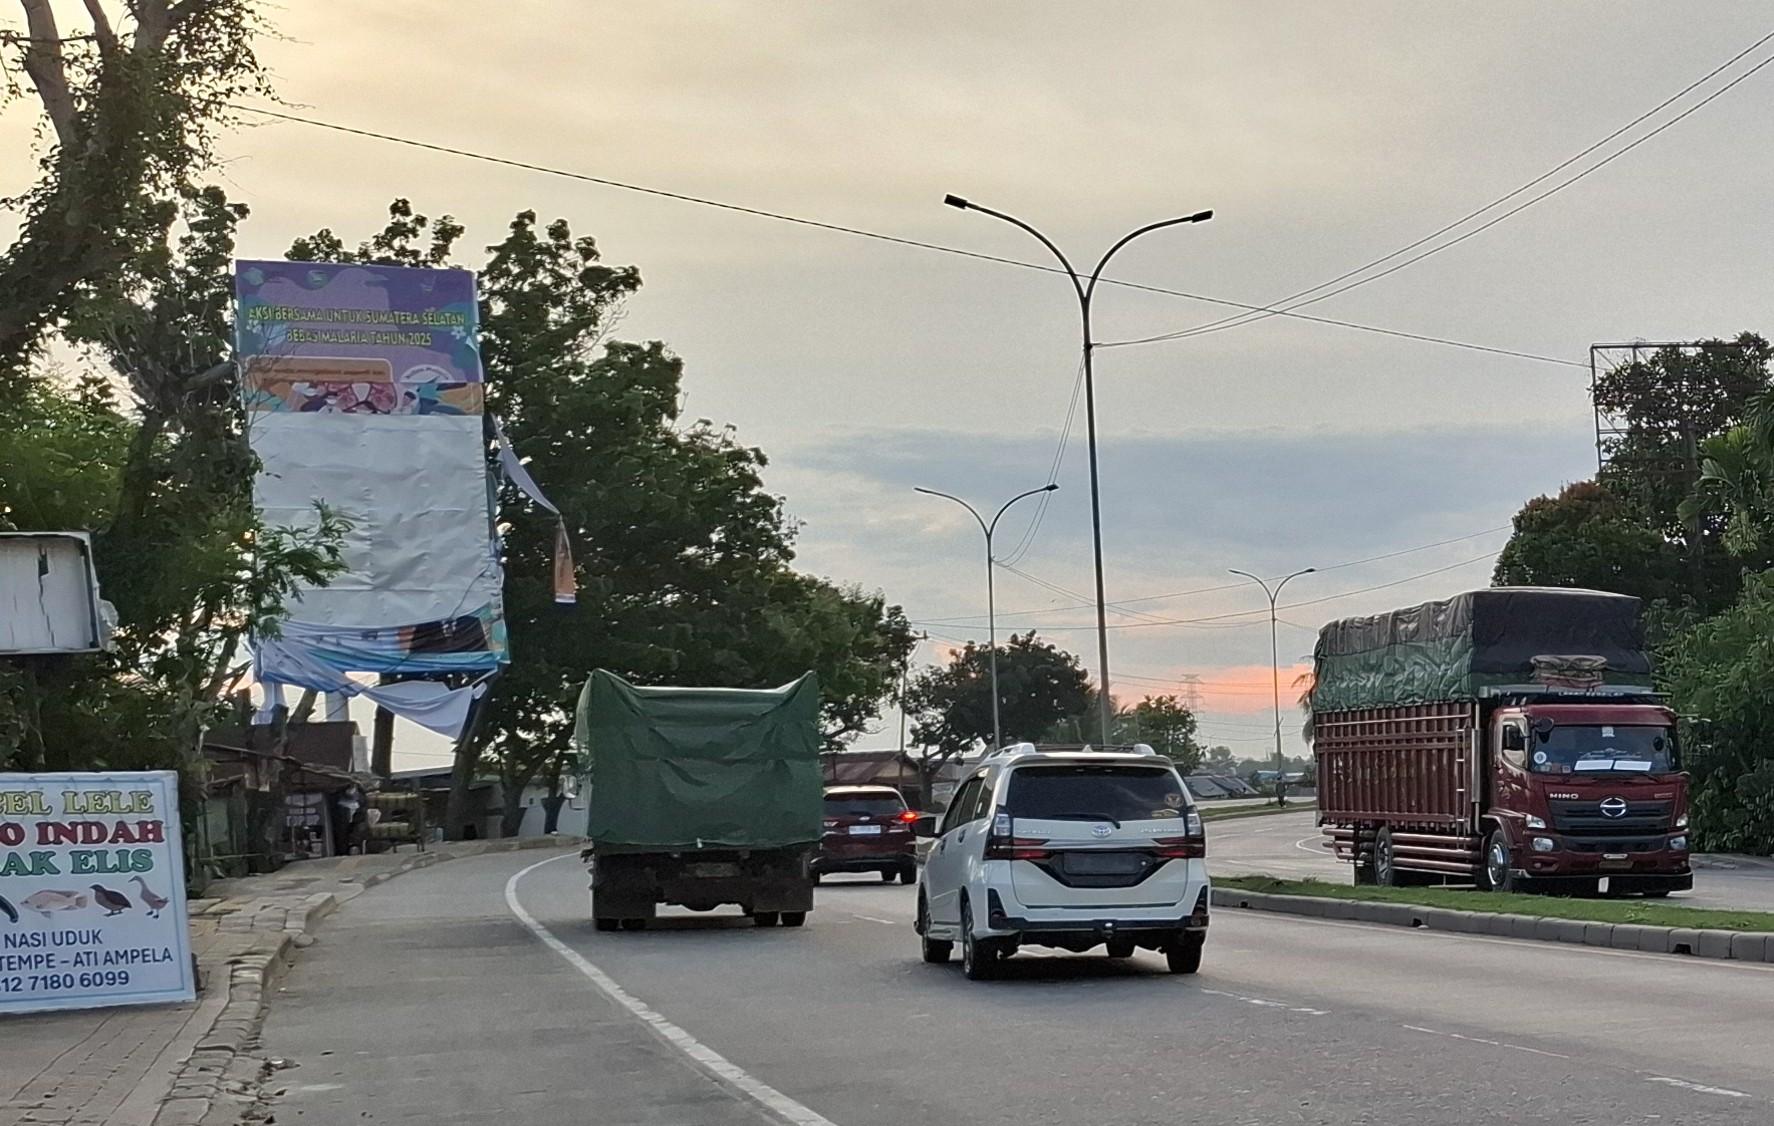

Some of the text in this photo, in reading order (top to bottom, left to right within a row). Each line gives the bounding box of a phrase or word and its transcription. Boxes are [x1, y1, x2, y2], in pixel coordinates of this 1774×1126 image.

[248, 306, 465, 326] AKSI BERSAMA UNTUK SUMATERA SELATAN
[287, 328, 432, 346] BEBAS MALARIA TAHUN 2025
[0, 791, 154, 815] EL LELE
[36, 820, 165, 845] INDAH
[69, 849, 154, 874] ELIS
[4, 929, 103, 949] NASI UDUK
[73, 951, 98, 967] ATI
[103, 947, 173, 966] AMPELA
[0, 970, 130, 992] 12 7180 6099
